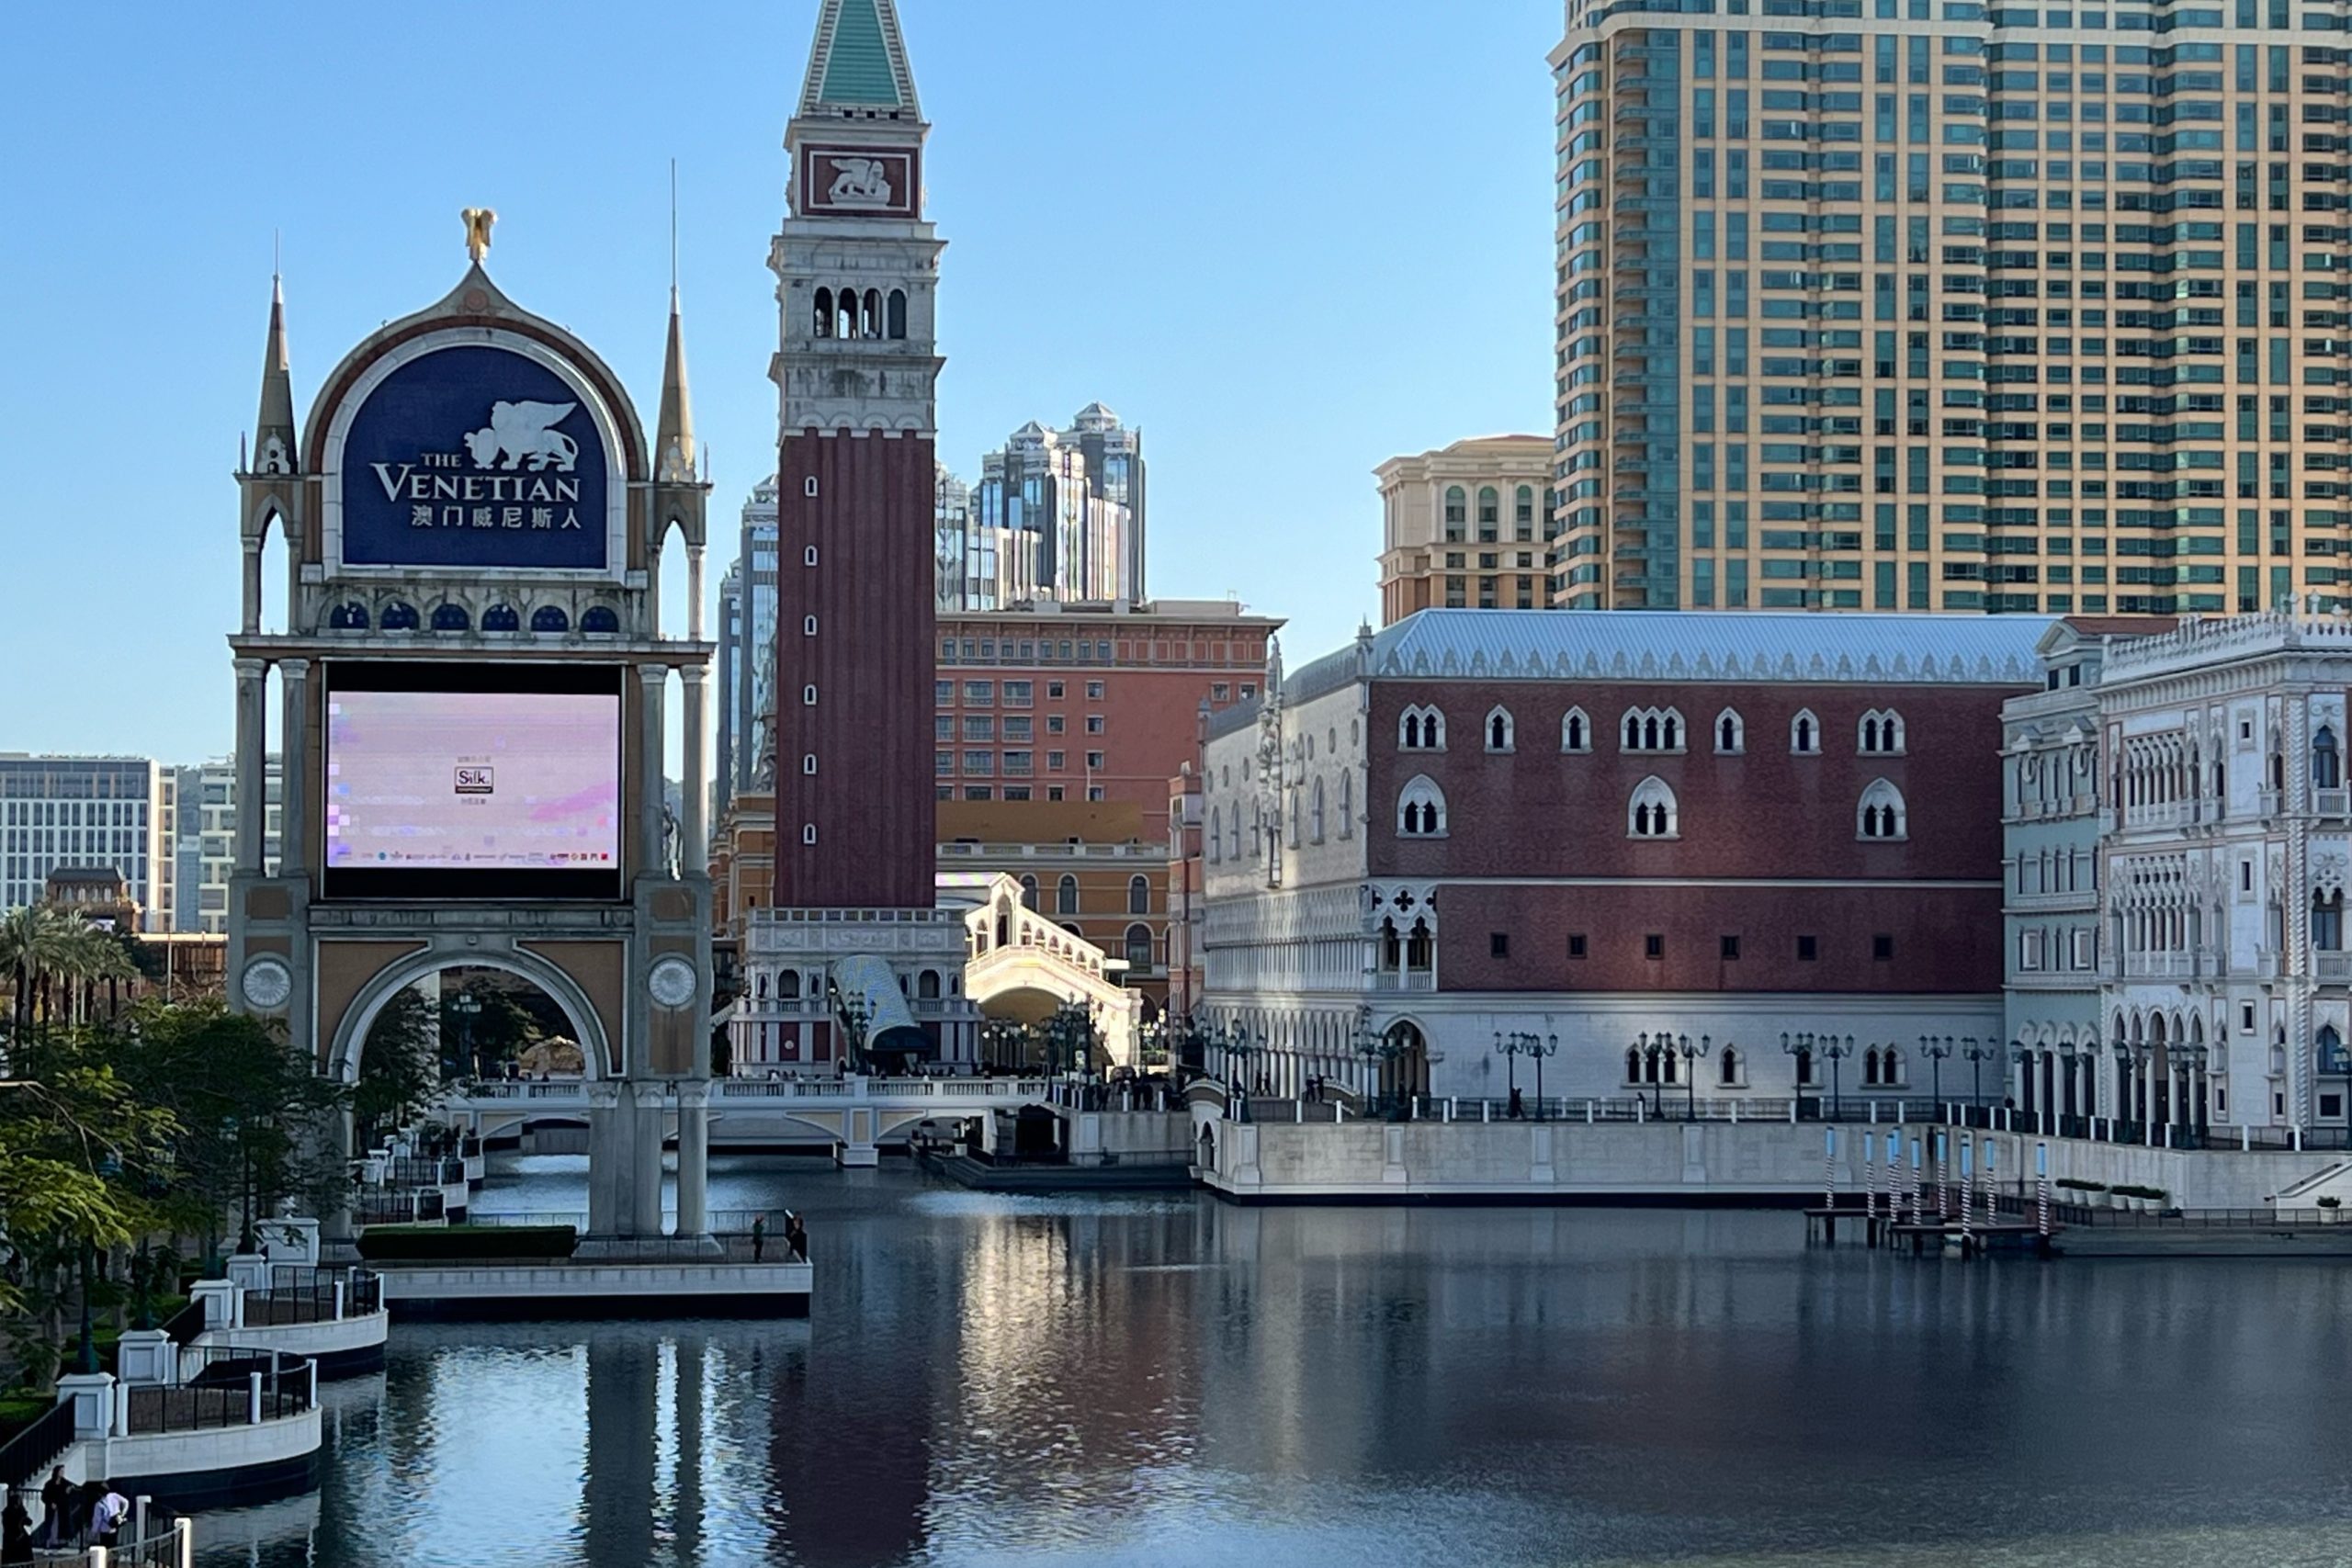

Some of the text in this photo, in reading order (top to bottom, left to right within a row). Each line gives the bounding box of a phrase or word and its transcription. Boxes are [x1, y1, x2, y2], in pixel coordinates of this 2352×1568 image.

[420, 452, 462, 468] THE
[368, 462, 581, 502] VENETIAN
[411, 504, 582, 530] 澳门威尼斯人
[458, 770, 486, 784] Silk
